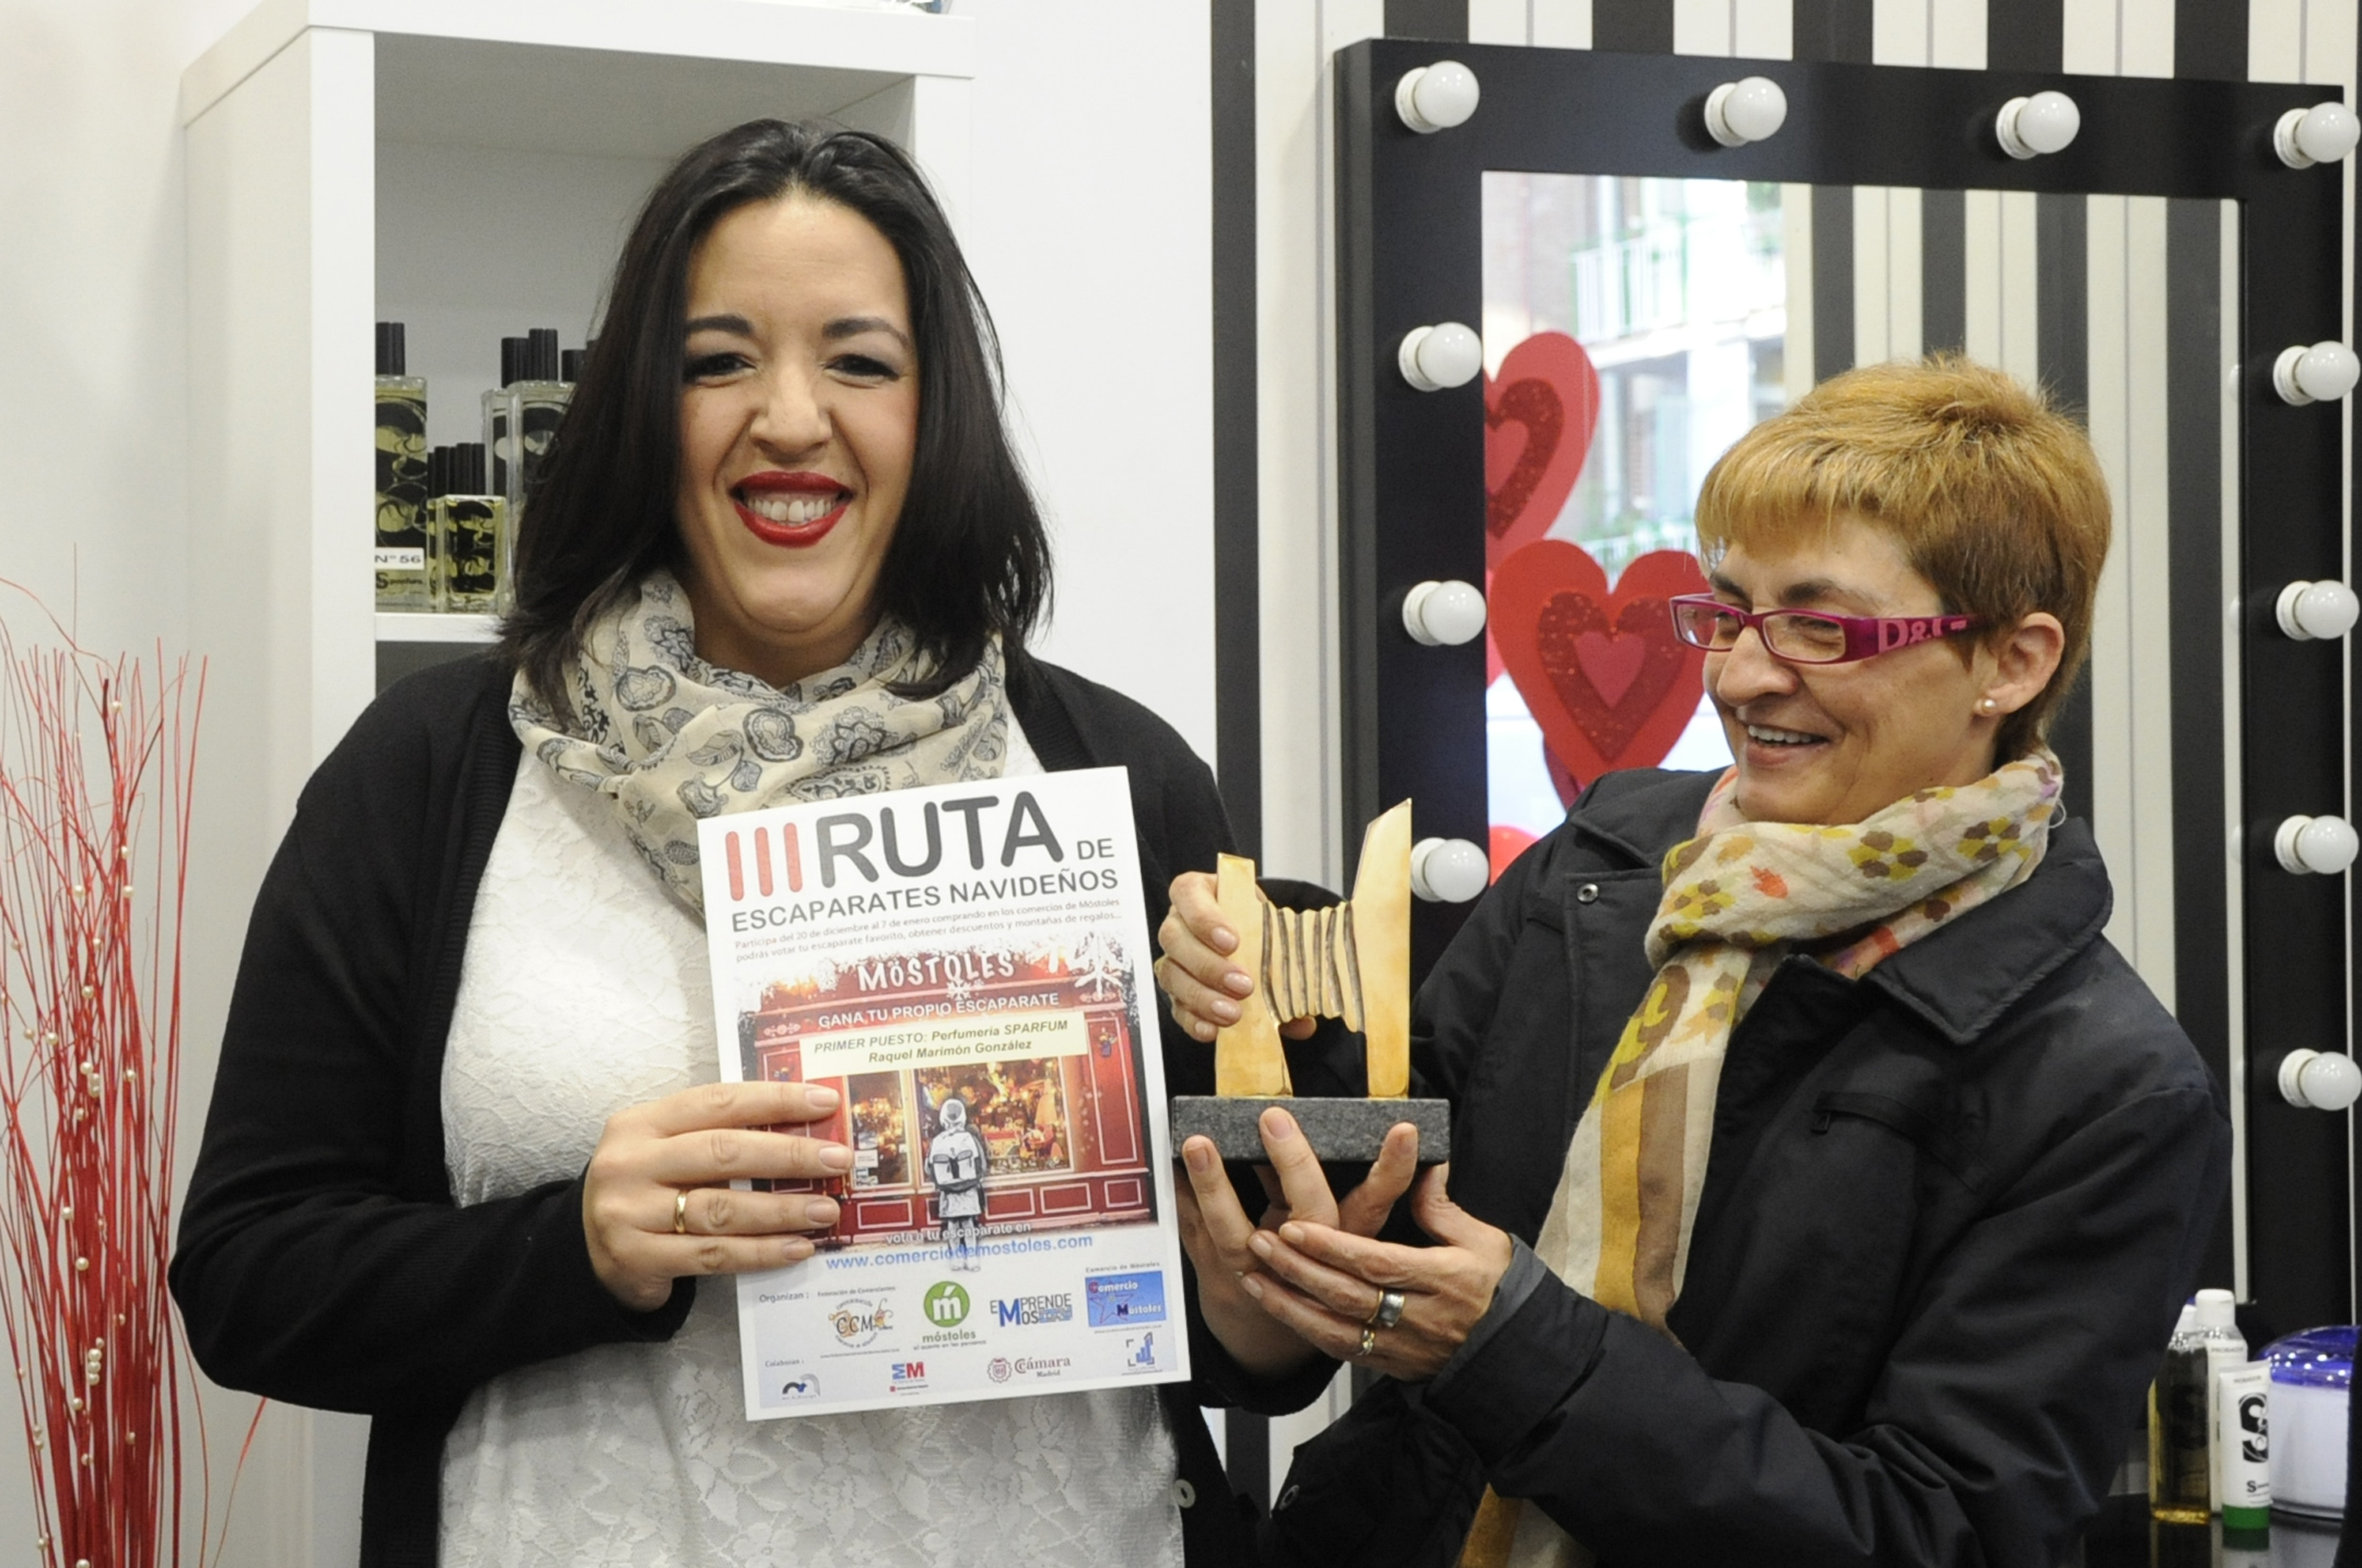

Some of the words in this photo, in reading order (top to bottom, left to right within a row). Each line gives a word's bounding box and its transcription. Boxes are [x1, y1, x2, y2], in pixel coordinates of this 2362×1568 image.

[399, 555, 422, 564] 56
[725, 822, 803, 901] III
[816, 791, 1064, 889] RUTA
[1077, 838, 1116, 860] DE
[732, 885, 941, 932] ESCAPARATES
[949, 867, 1119, 904] NAVIDEÑOS
[735, 937, 777, 949] Participa
[779, 932, 794, 943] del
[796, 931, 808, 940] 20
[809, 928, 821, 938] de
[823, 923, 869, 936] diciembre
[871, 921, 879, 930] al
[882, 920, 887, 929] 7
[889, 919, 901, 928] de
[903, 916, 930, 926] enero
[932, 911, 986, 926] comprando
[988, 909, 999, 917] en
[1001, 906, 1015, 916] los
[1016, 904, 1063, 915] comercios
[1066, 900, 1077, 910] de
[1079, 898, 1120, 909] Móstoles
[736, 949, 769, 963] podrás
[771, 946, 796, 956] votar
[799, 944, 809, 952] tu
[811, 937, 863, 951] escaparate
[865, 931, 906, 944] favorito,
[908, 926, 947, 938] obtener
[949, 921, 1005, 934] descuentos
[1006, 921, 1012, 930] y
[1015, 916, 1062, 927] montañas
[1065, 914, 1077, 923] de
[818, 1011, 865, 1028] GANA
[867, 1009, 888, 1022] TU
[892, 1002, 952, 1019] PROPIO
[955, 993, 1060, 1014] ESCAPARATE
[814, 1038, 865, 1054] PRIMER
[869, 1032, 928, 1048] PUESTO:
[1004, 1020, 1068, 1036] SPARFUM
[869, 1049, 913, 1064] Raquel
[916, 1044, 971, 1059] Marimón
[975, 1039, 1033, 1054] González
[885, 1232, 914, 1245] vota
[926, 1229, 940, 1241] tu
[942, 1224, 1013, 1240] escaparate
[1015, 1222, 1031, 1234] en
[826, 1235, 1093, 1269] www.comerciodemostoles.com
[922, 1329, 977, 1343] móstoles
